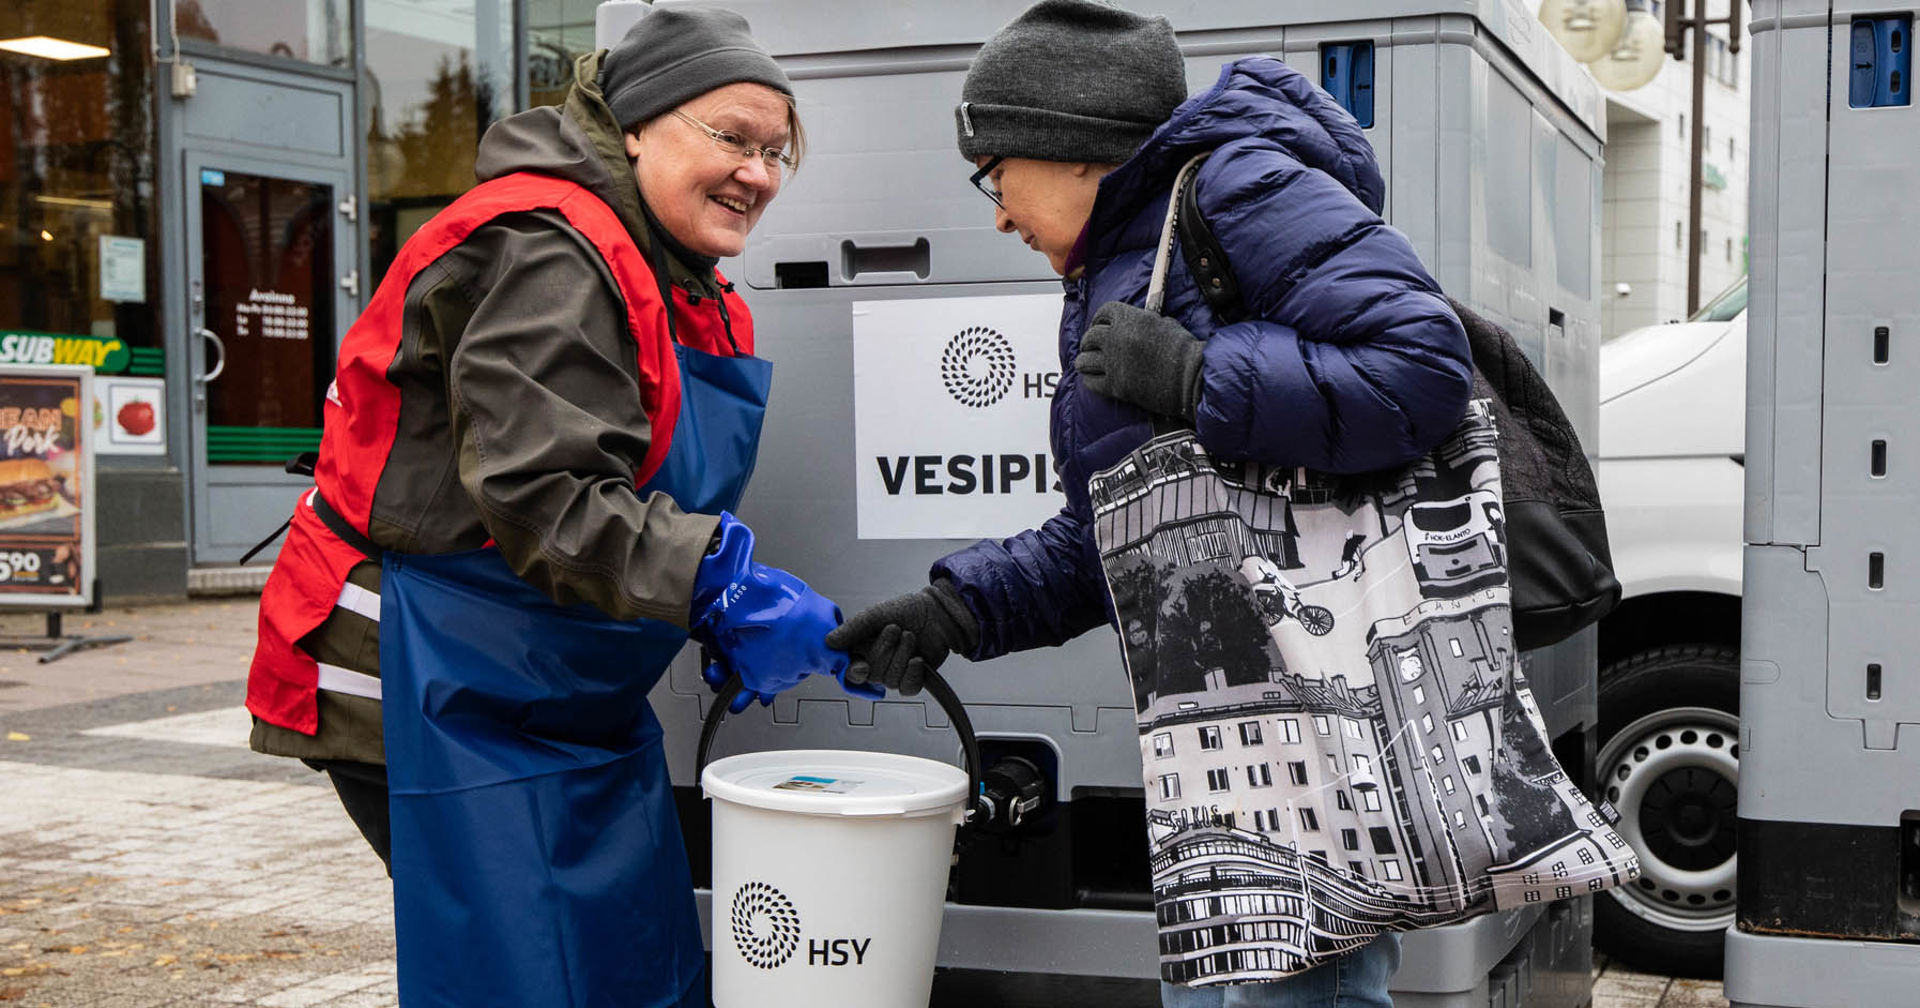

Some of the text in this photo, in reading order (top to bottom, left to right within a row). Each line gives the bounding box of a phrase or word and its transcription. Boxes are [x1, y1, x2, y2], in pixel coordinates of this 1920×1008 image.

[0, 334, 121, 367] SUBWAY
[1024, 372, 1063, 398] HS
[3, 424, 60, 456] Pork
[809, 938, 872, 966] HSY
